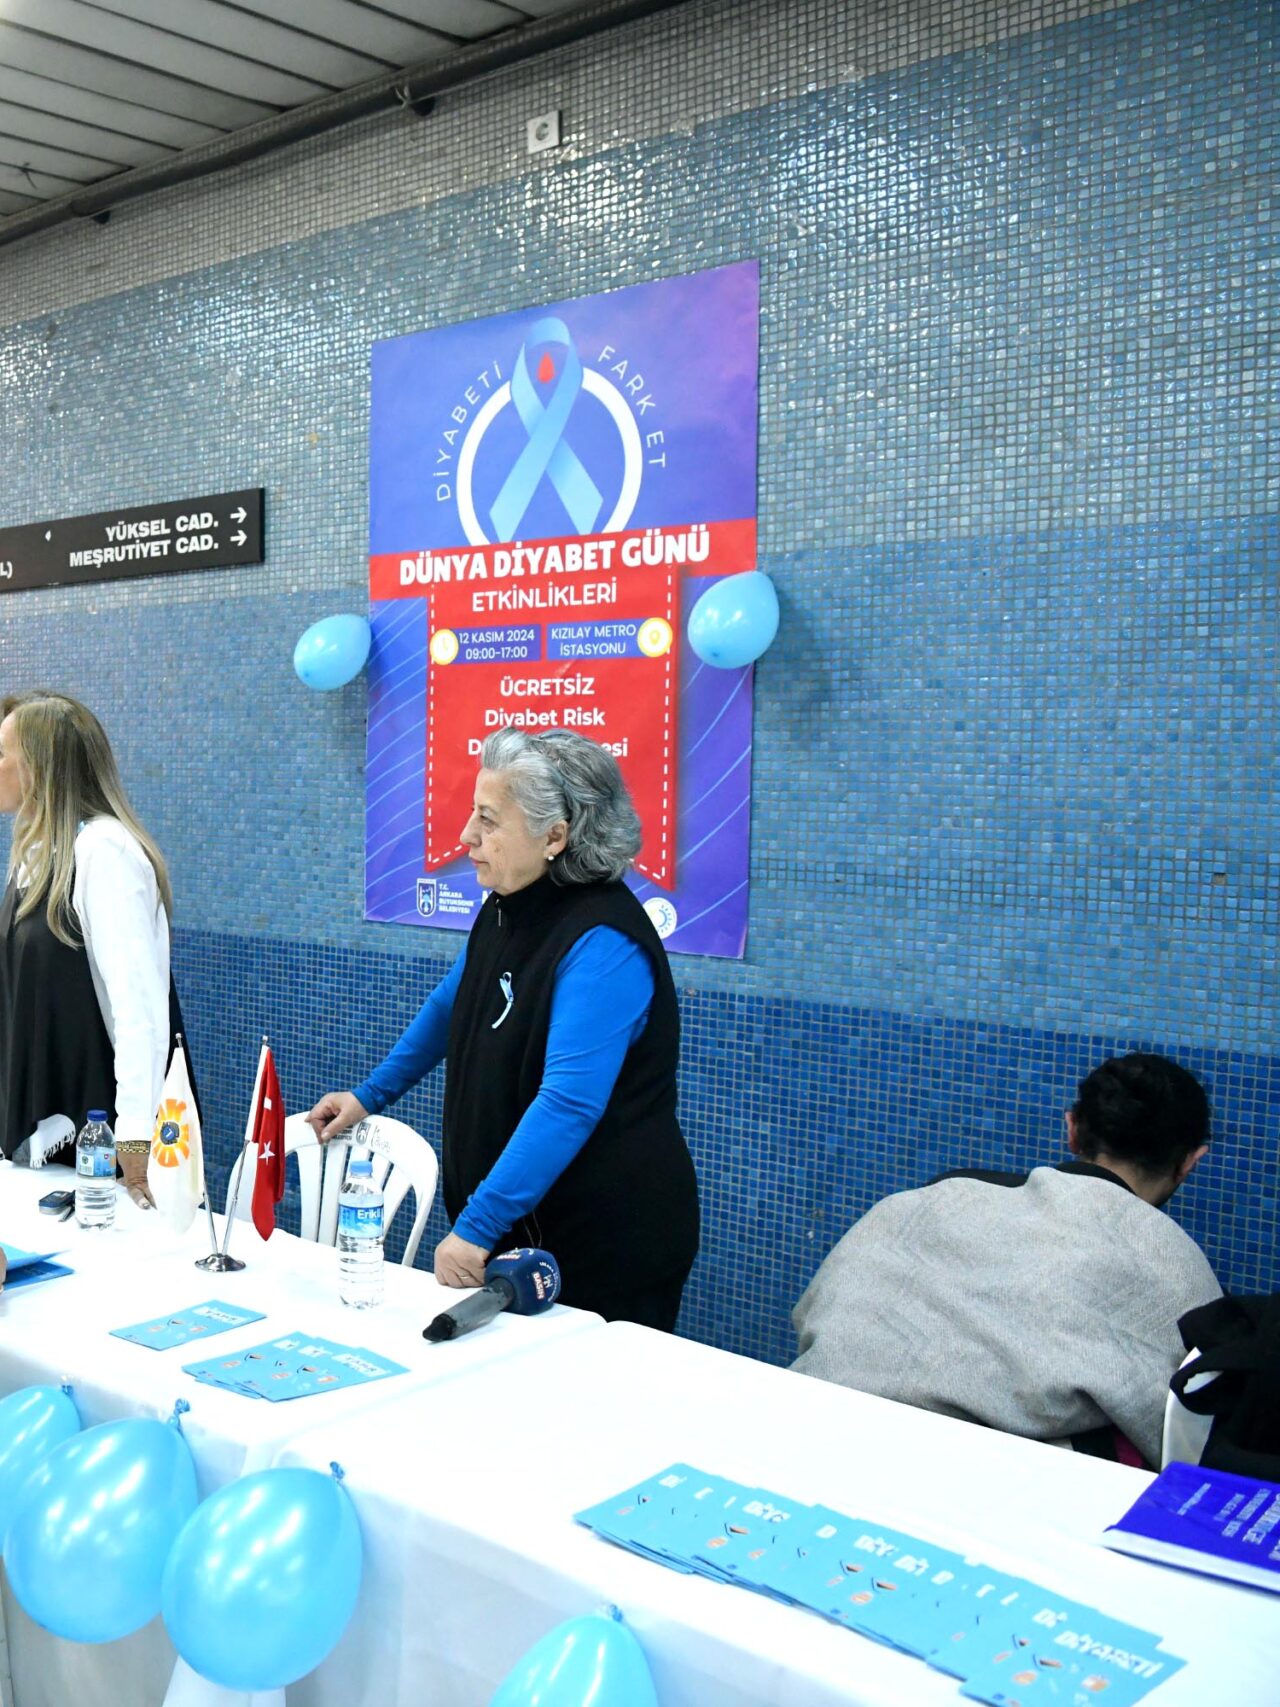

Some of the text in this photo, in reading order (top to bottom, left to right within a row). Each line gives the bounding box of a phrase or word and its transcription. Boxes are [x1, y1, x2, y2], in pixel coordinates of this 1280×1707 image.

[596, 344, 666, 469] FARK ET
[432, 360, 505, 502] DİYABETİ
[105, 510, 220, 543] YÜKSEL CAD.
[69, 533, 220, 569] MEŞRUTİYET CAD.
[399, 524, 710, 585] DÜNYA DİYABET GÜNÜ
[471, 576, 617, 613] ETKİNLİKLERİ
[458, 628, 535, 644] 12 KASIM 2024
[551, 623, 637, 640] KIZILAY METRO
[465, 646, 528, 660] 09:00-17:00
[559, 642, 626, 656] İSTASYONU
[500, 673, 595, 697] ÜCRETSİZ
[484, 707, 606, 728] Diyabet Risk
